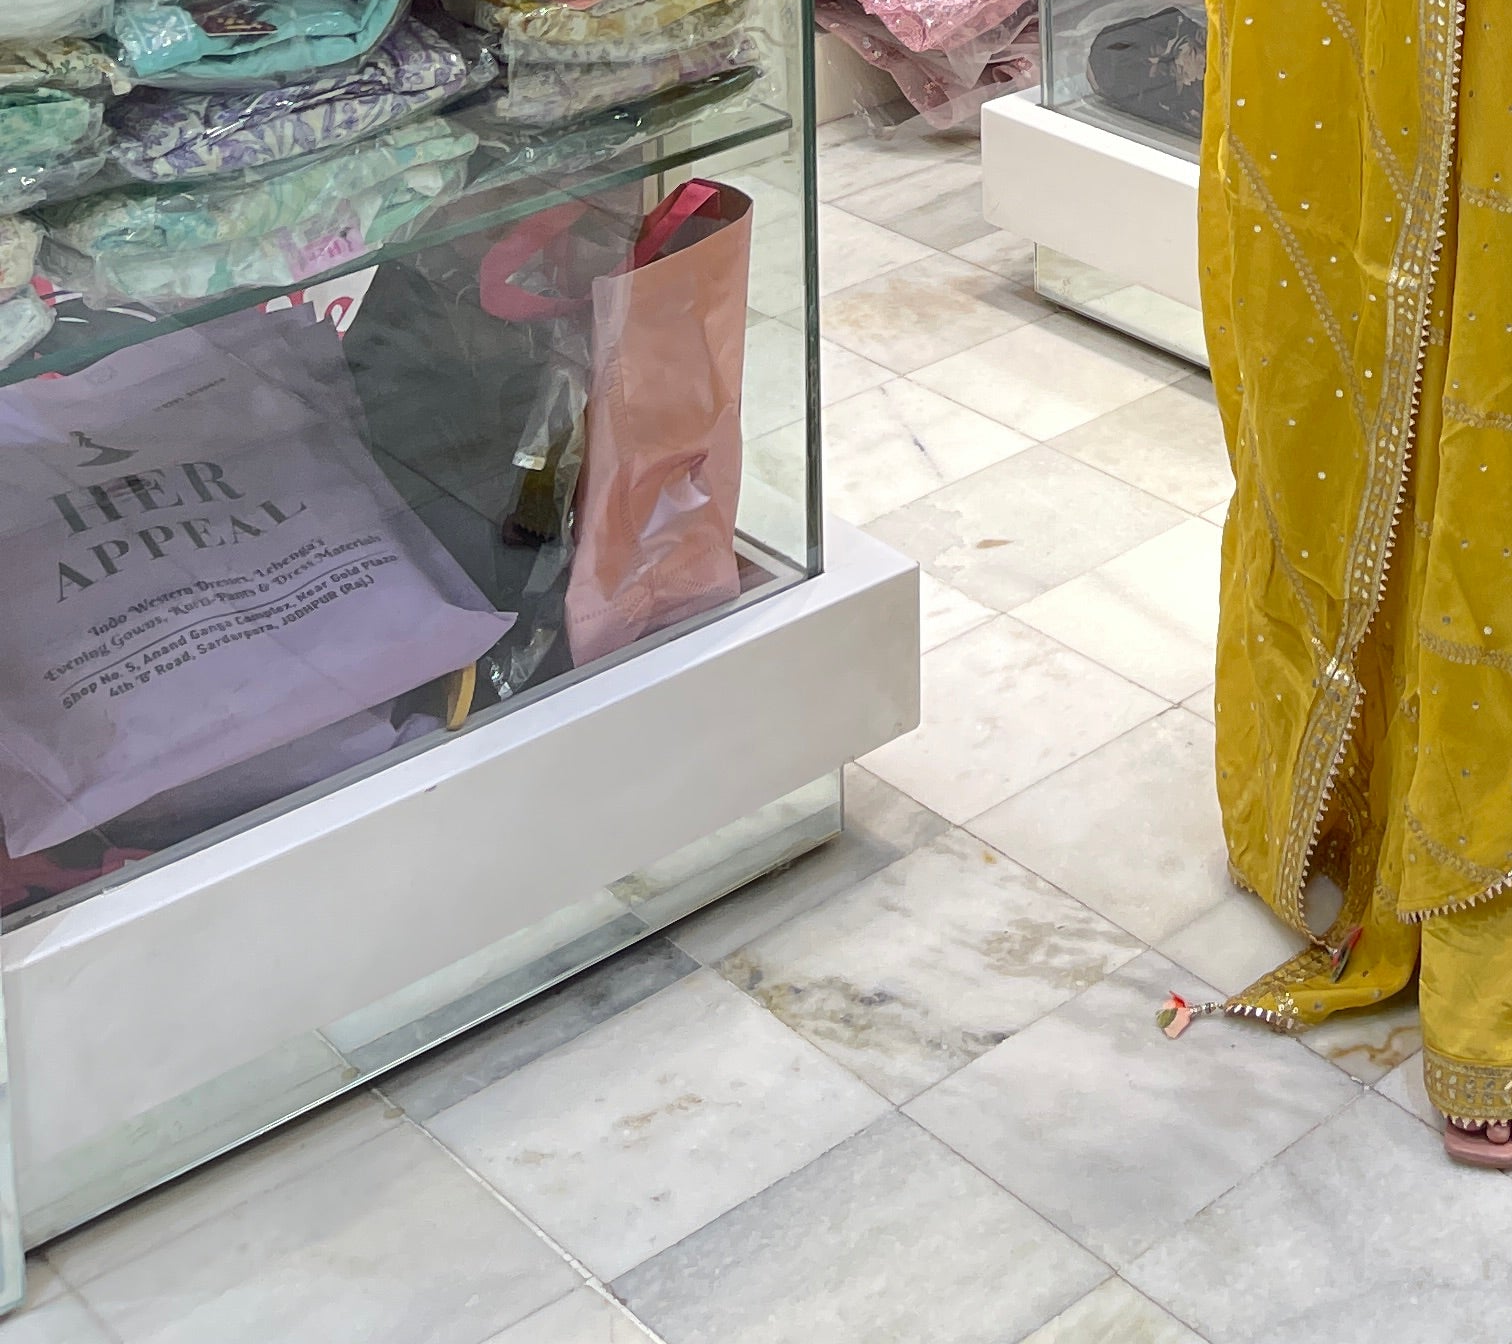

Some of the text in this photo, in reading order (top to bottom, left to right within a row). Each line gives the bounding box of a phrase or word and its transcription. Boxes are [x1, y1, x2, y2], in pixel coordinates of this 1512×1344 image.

[47, 461, 247, 538] HER
[57, 499, 308, 604] APPEAL
[43, 643, 112, 682] Evening
[62, 681, 98, 710] Shop
[99, 671, 124, 686] No.
[143, 634, 188, 665] Anand
[189, 619, 233, 640] Ganga
[296, 580, 328, 602] Near
[329, 566, 361, 583] Gold
[109, 681, 135, 697] 4th
[281, 590, 339, 626] JODHPUR
